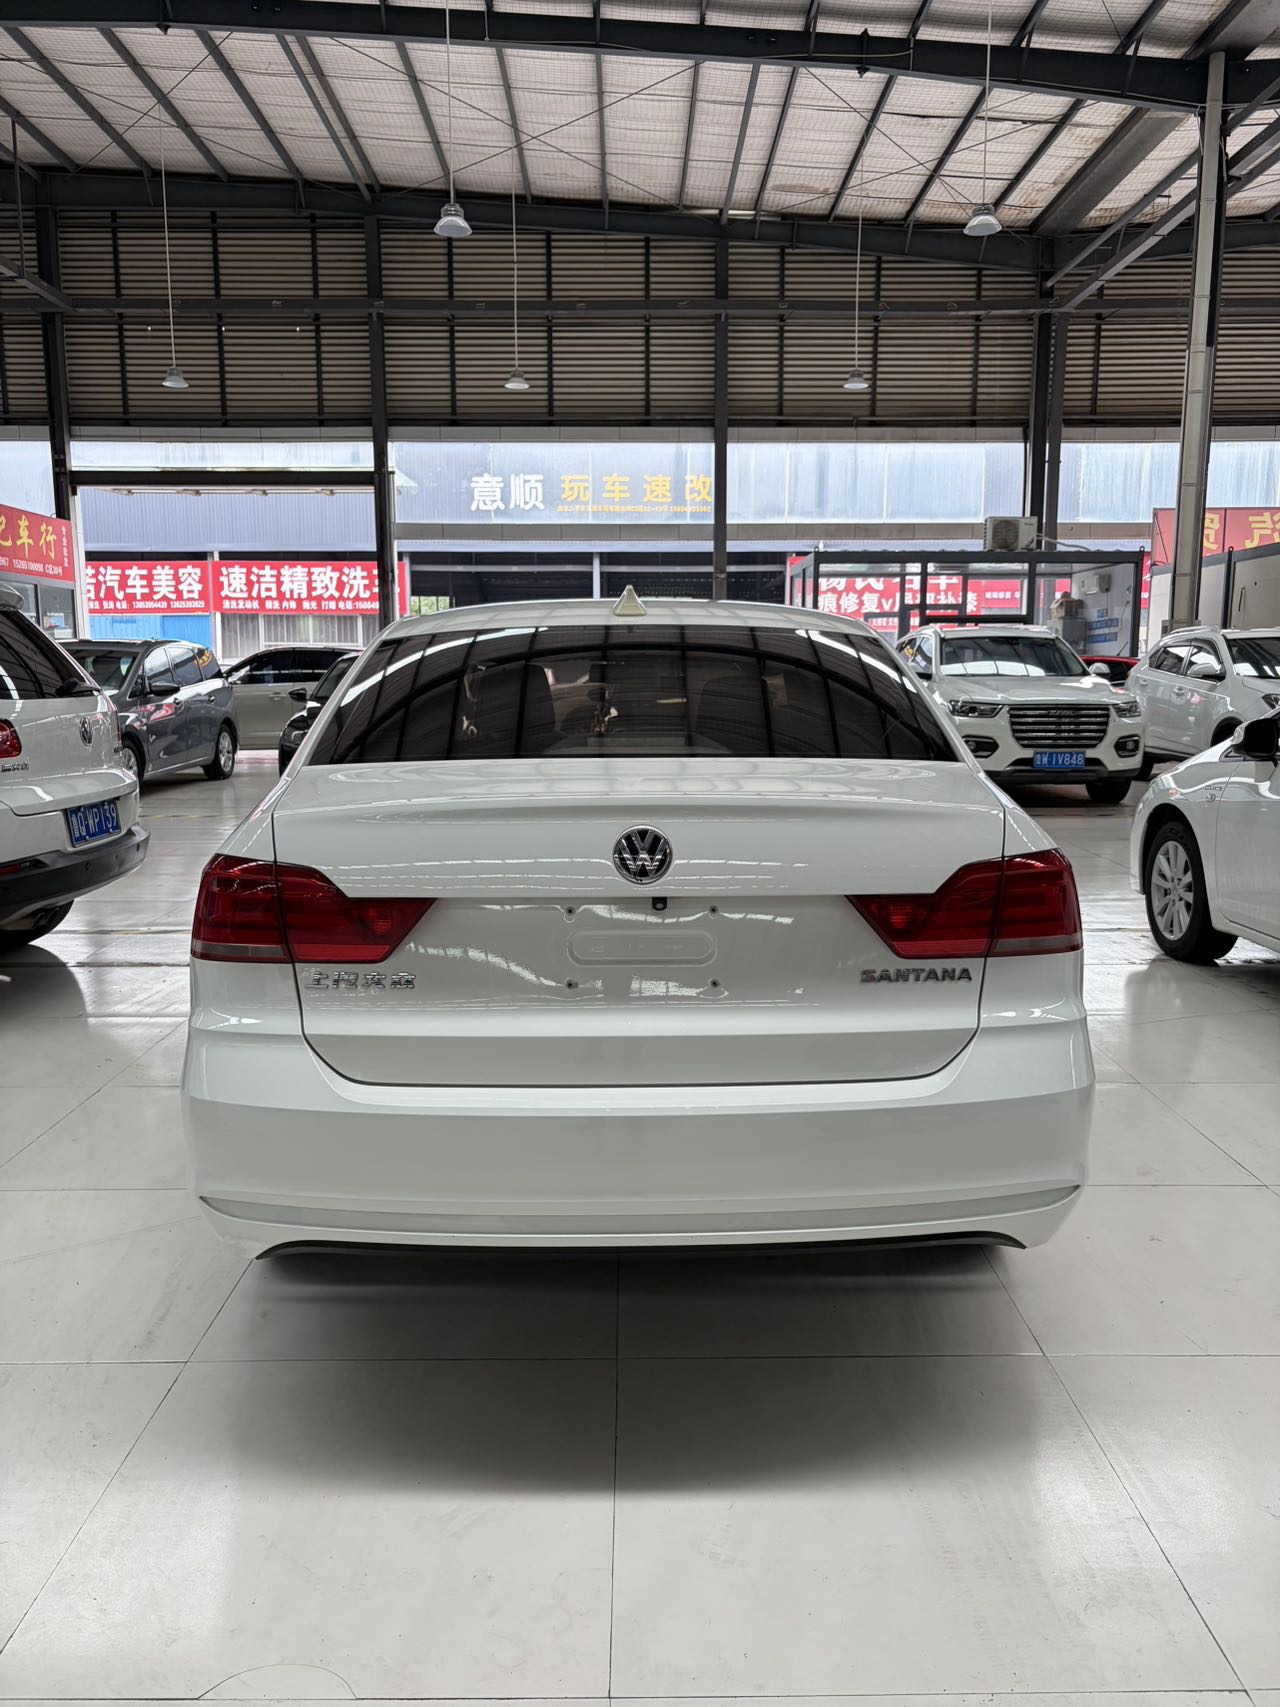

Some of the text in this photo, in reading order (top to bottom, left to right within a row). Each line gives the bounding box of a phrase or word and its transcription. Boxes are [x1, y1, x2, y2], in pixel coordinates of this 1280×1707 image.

[470, 472, 713, 512] 意顺 玩车速改
[219, 565, 399, 599] 速洁精致洗
[861, 967, 973, 983] SANTANA
